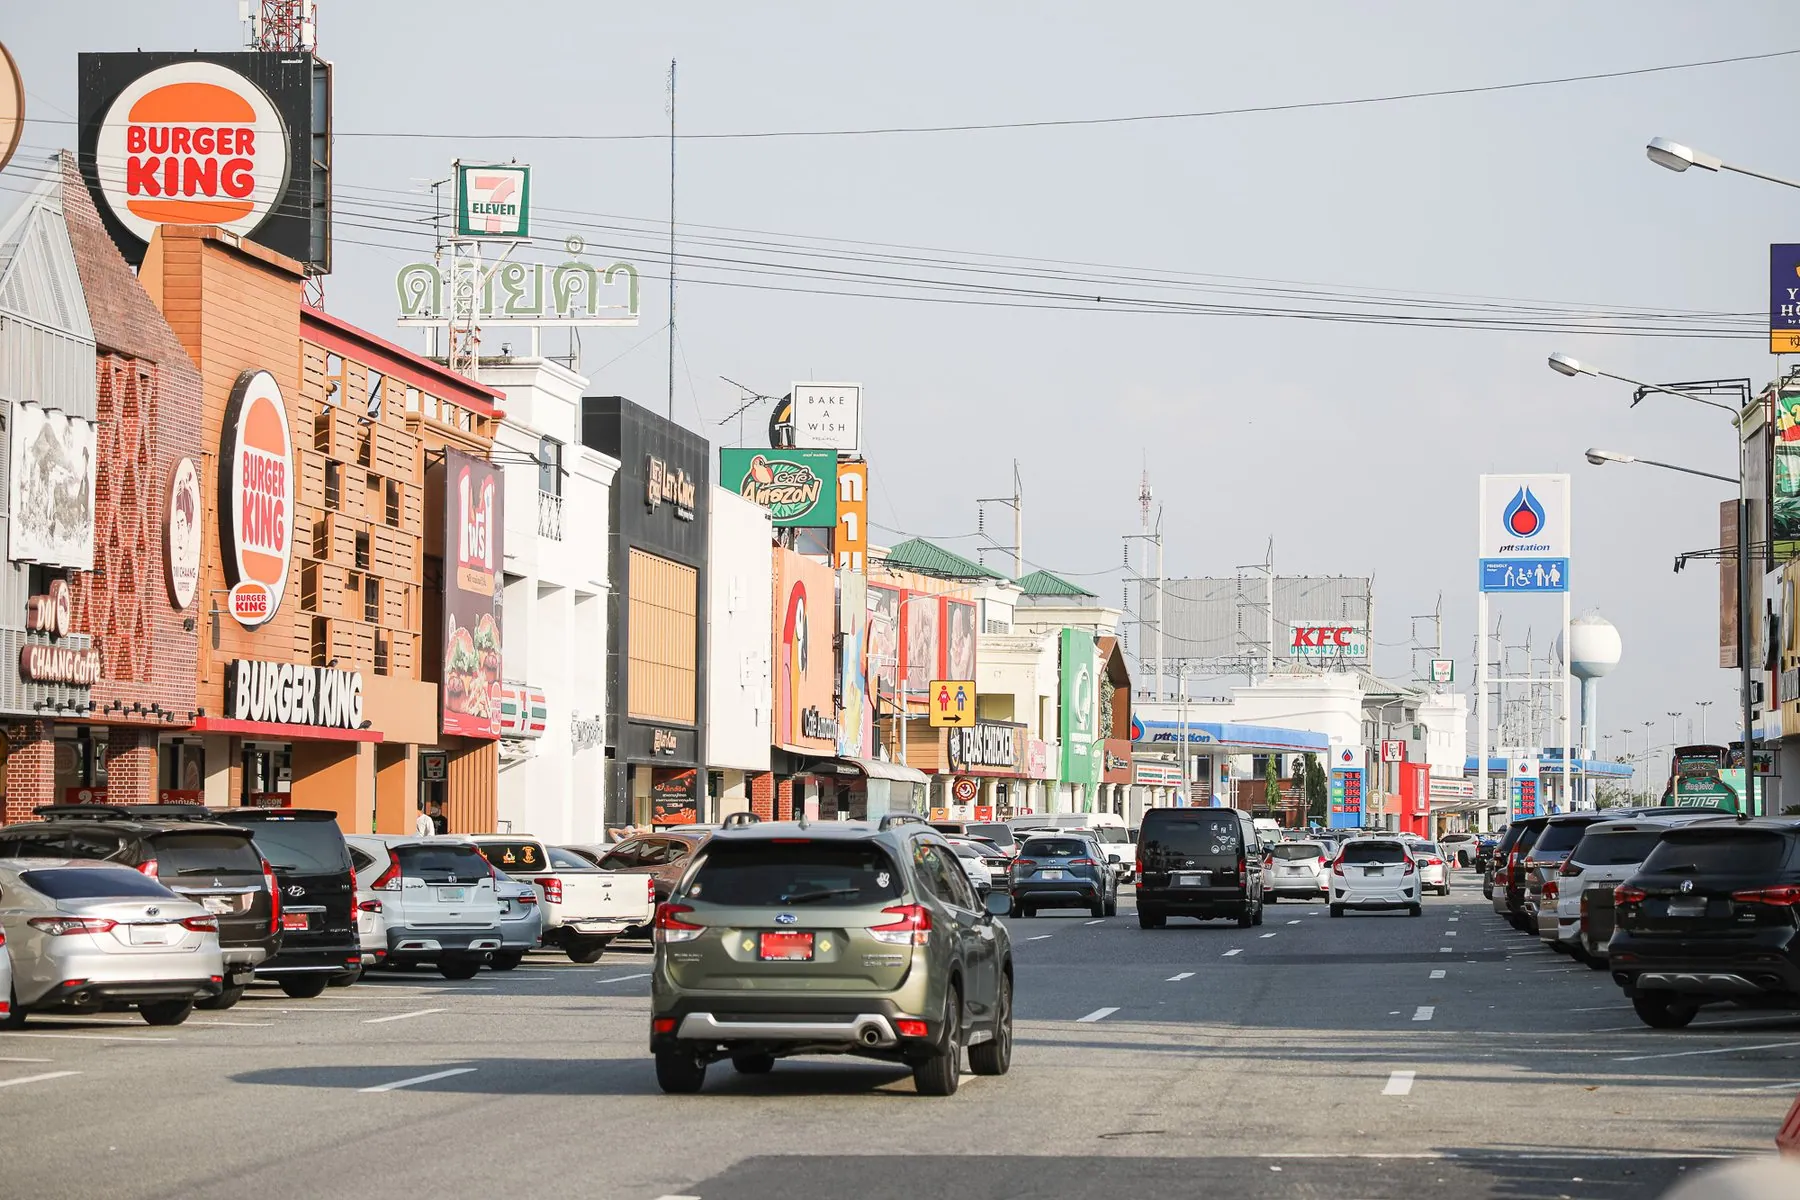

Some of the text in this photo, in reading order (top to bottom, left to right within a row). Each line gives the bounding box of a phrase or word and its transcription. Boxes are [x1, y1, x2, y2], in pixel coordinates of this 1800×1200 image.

[127, 125, 256, 156] BURGER
[127, 157, 256, 198] KING
[808, 396, 845, 405] BAKE
[822, 410, 830, 418] A
[808, 423, 845, 431] WISH
[242, 450, 285, 500] BURGER
[241, 493, 285, 552] KING
[1515, 543, 1550, 552] station
[235, 594, 267, 602] BURGER
[235, 602, 267, 612] KING
[36, 599, 56, 631] DOI
[1292, 627, 1353, 646] KFC
[30, 647, 73, 680] CHAANG
[236, 659, 363, 729] BURGER KING
[962, 726, 983, 771] TEXAS
[983, 725, 1014, 765] CHICKEN
